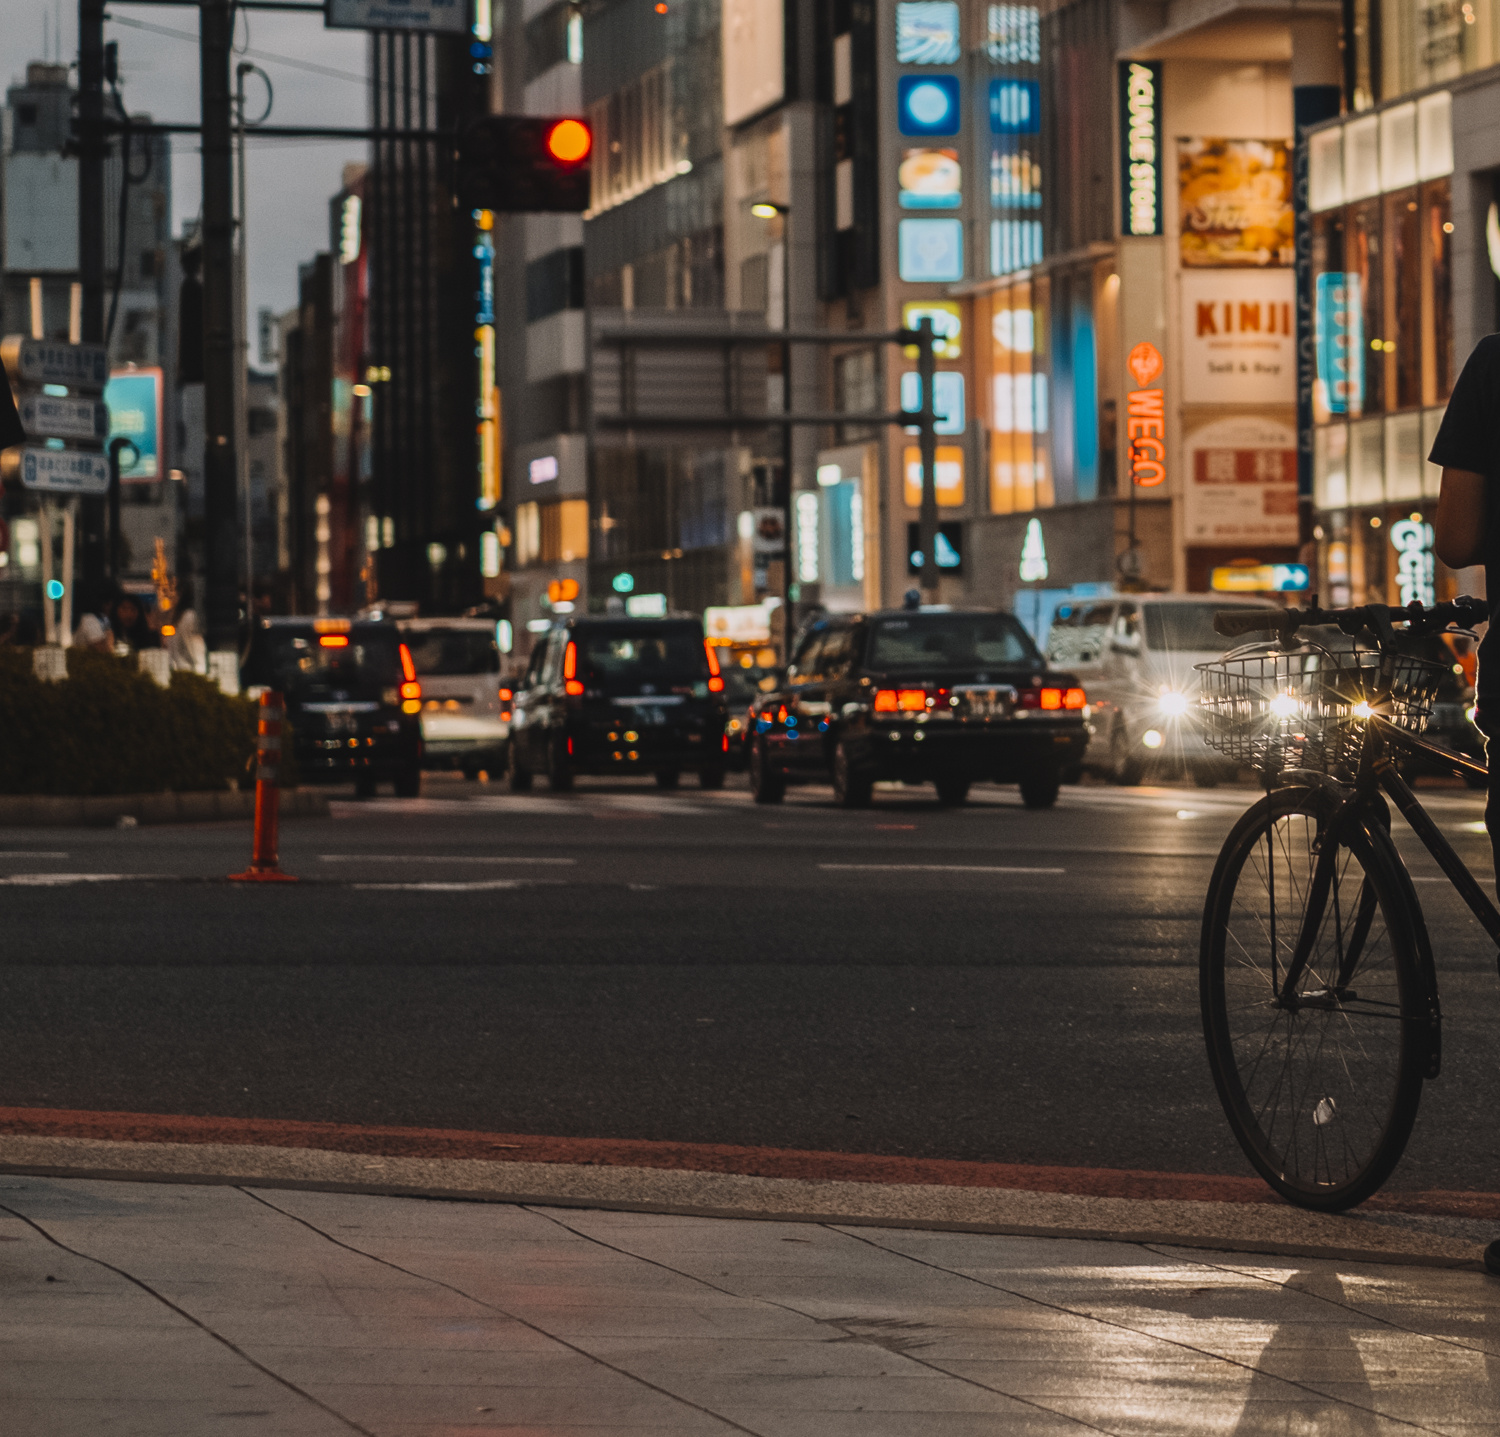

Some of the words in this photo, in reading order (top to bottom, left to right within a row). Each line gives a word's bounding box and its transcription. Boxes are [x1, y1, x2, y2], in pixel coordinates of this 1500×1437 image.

[1128, 63, 1156, 164] ACUVUE
[1129, 162, 1157, 235] STORE
[1196, 301, 1290, 337] KINJI
[1127, 388, 1166, 487] WEGO
